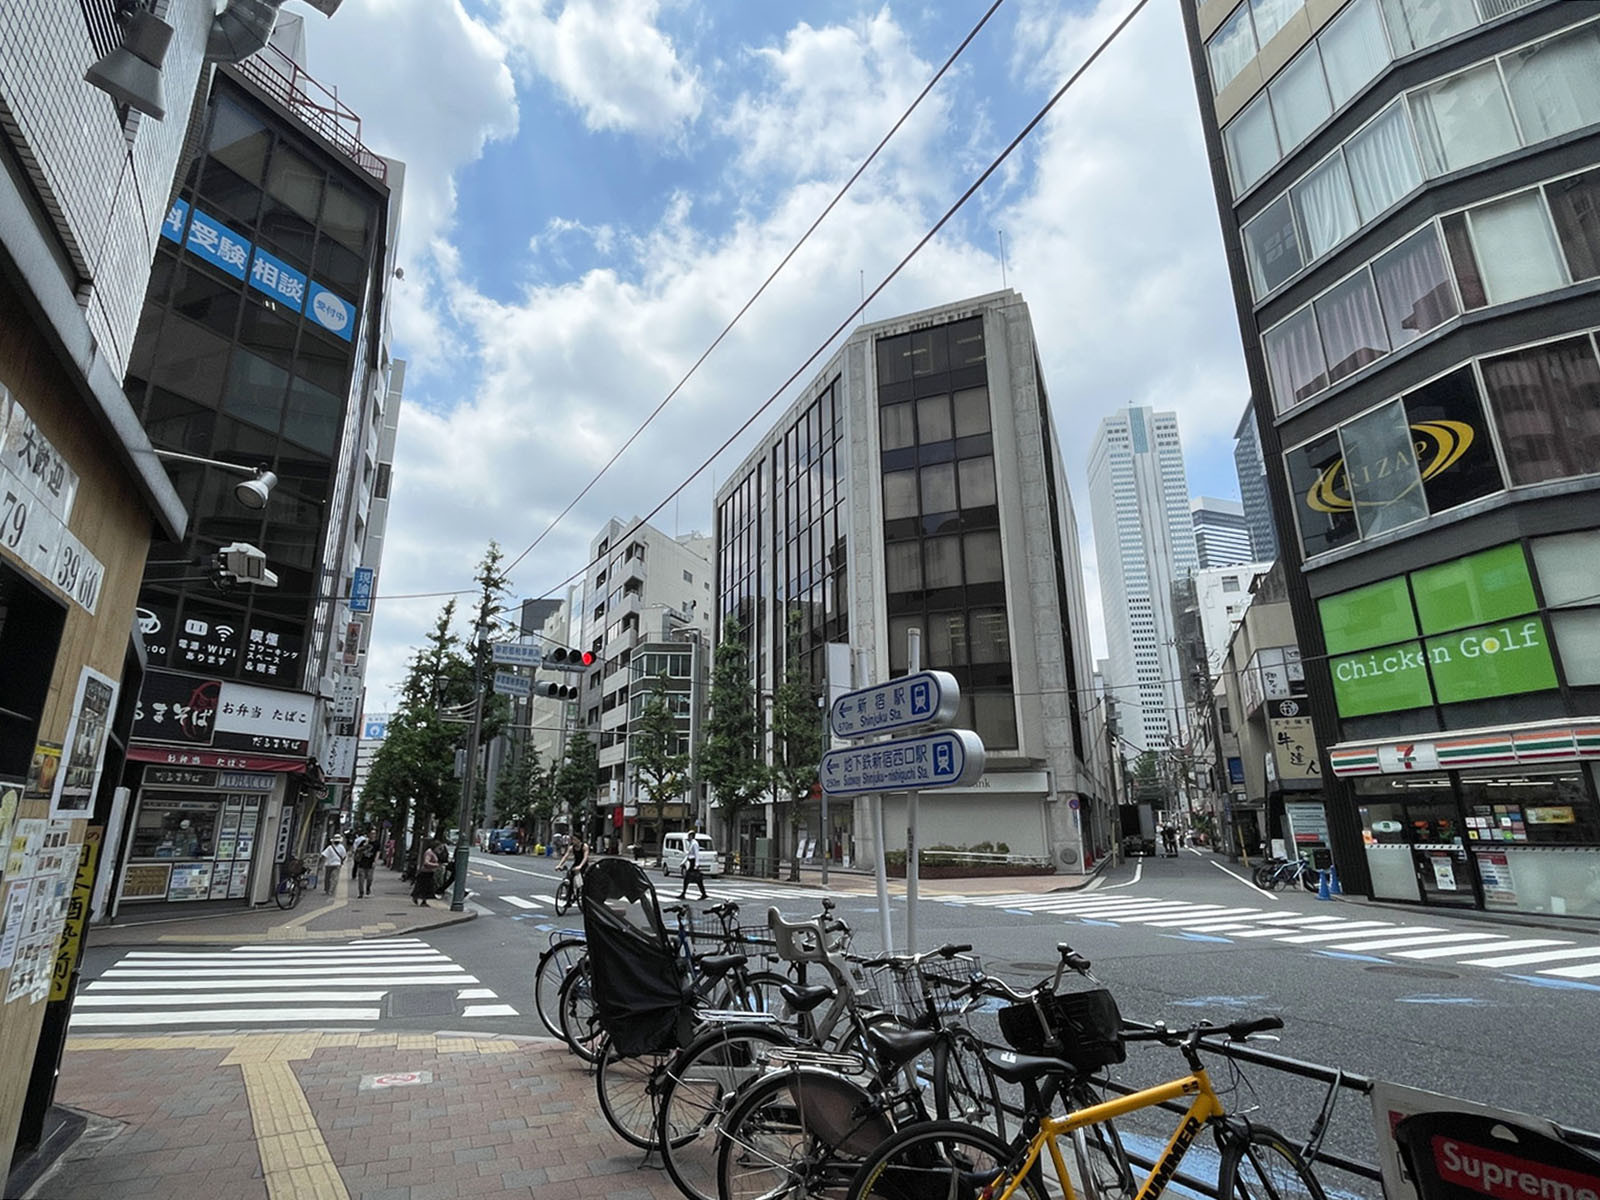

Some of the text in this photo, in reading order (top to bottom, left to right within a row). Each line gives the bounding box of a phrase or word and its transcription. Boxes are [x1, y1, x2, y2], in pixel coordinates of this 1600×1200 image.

[316, 300, 345, 321] 受付中
[18, 429, 65, 498] 大歓迎
[1342, 440, 1428, 491] RIZAP
[185, 652, 227, 666] あります
[247, 652, 280, 664] スペース
[248, 644, 298, 660] コワーキング
[1336, 623, 1539, 682] Chicken Golf
[857, 687, 905, 714] 新宿駅
[222, 702, 307, 723] お弁当 たばこ
[860, 713, 888, 728] Shinjuku
[890, 708, 903, 721] Sta.
[252, 737, 301, 750] だるまそば
[216, 758, 248, 767] たばこ
[843, 744, 929, 772] 地下鉄新宿西口駅
[917, 764, 929, 779] Sta.
[1141, 1116, 1201, 1200] UMMER
